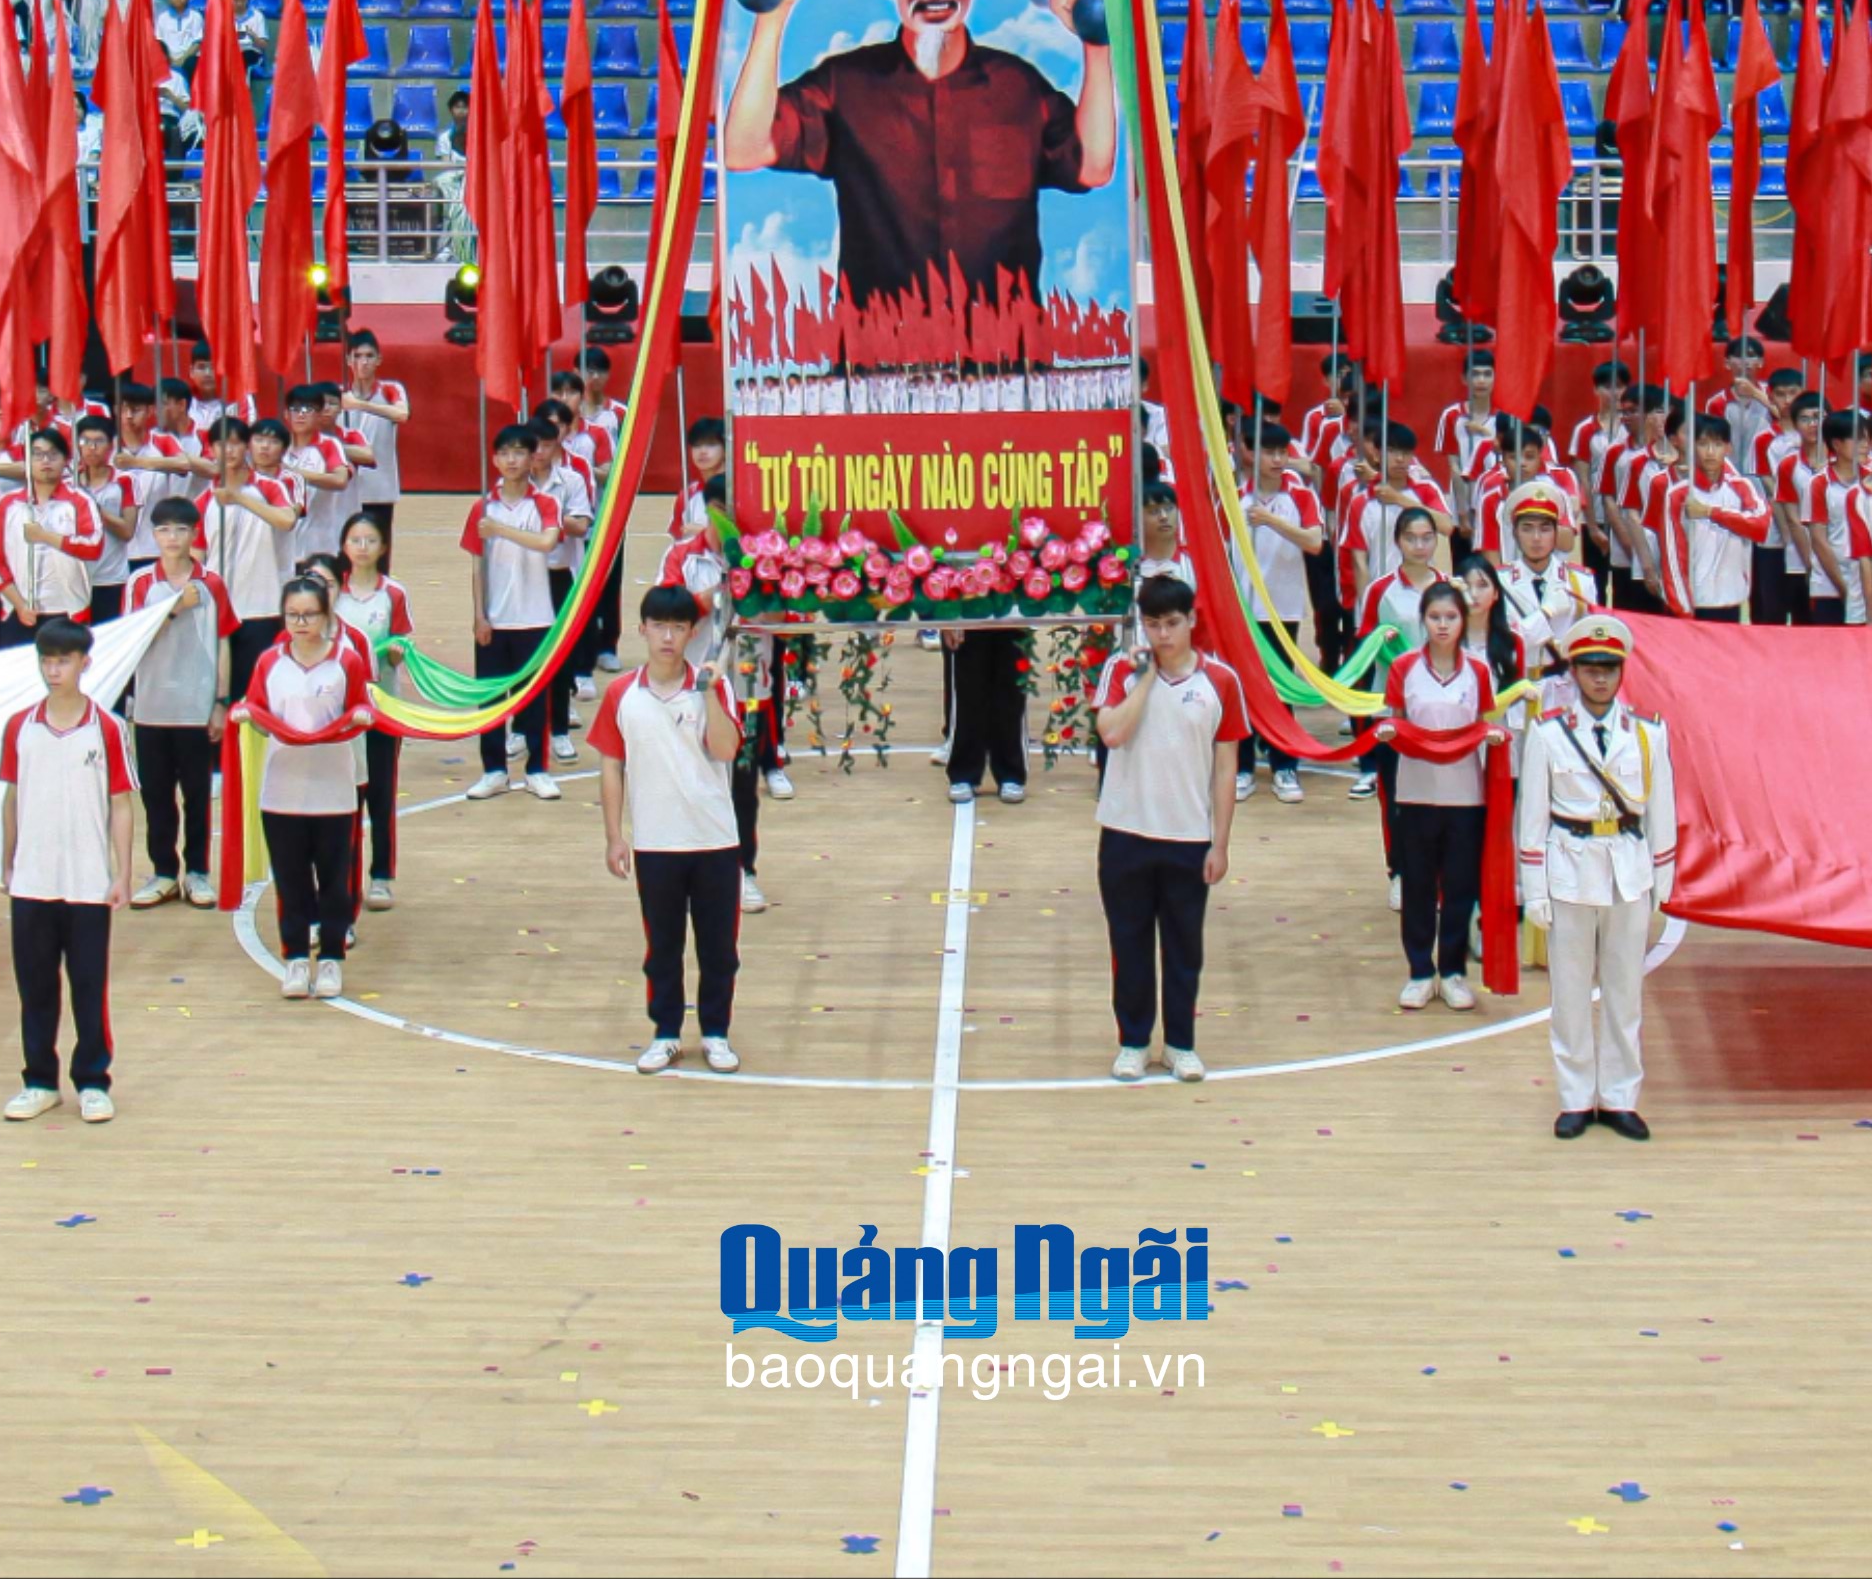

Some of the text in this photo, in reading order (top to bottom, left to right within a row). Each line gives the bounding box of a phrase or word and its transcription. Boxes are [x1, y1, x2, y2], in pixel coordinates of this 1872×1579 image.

[797, 443, 837, 513] TÔI
[845, 441, 914, 512] NGÀY
[921, 440, 975, 510] NÀO
[982, 441, 1053, 510] CŨNG
[1059, 434, 1124, 520] TẬP”
